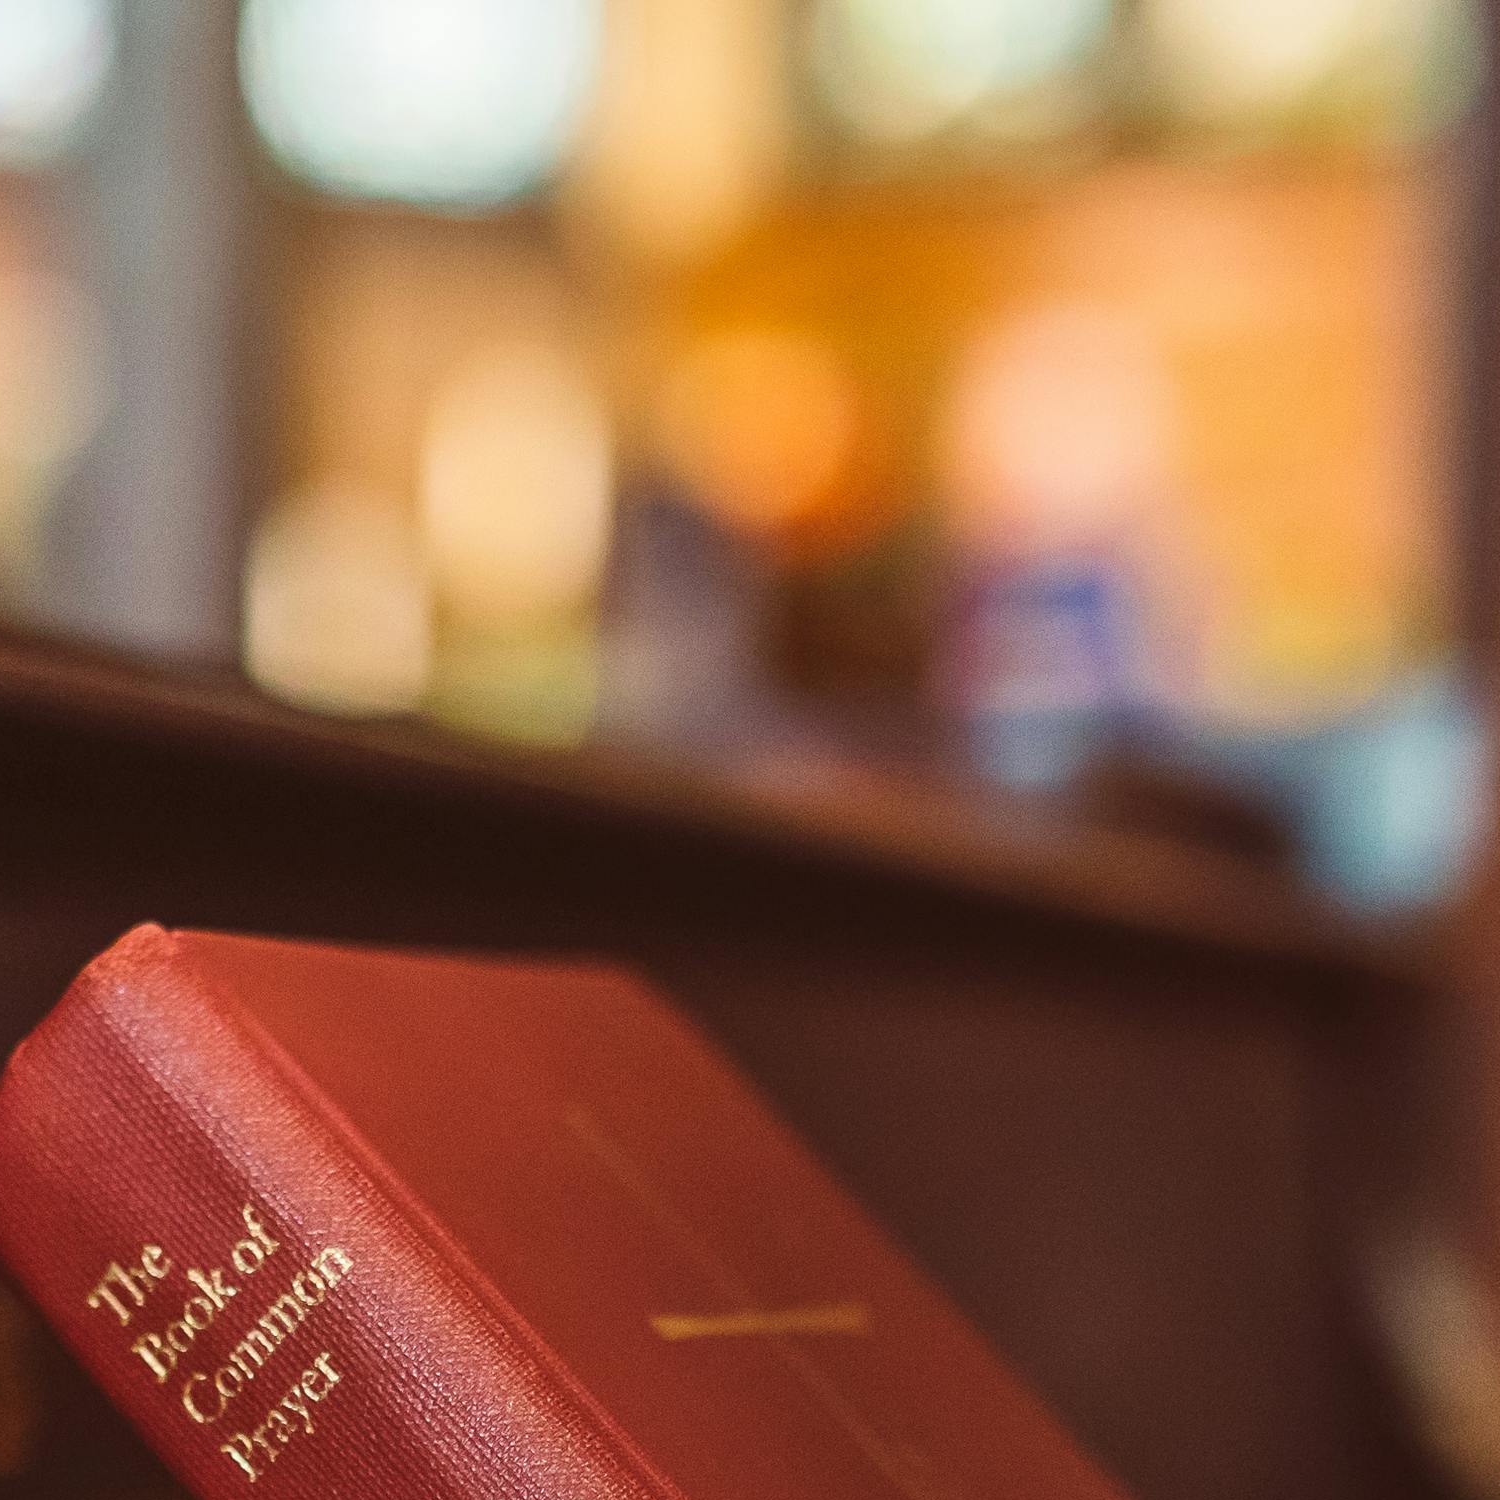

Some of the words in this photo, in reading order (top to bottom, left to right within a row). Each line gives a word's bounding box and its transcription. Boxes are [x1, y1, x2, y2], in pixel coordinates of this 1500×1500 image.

[87, 1241, 171, 1327] The
[131, 1267, 240, 1383] Book
[231, 1203, 280, 1274] of
[182, 1246, 354, 1423] Common
[220, 1352, 340, 1482] Prayer
